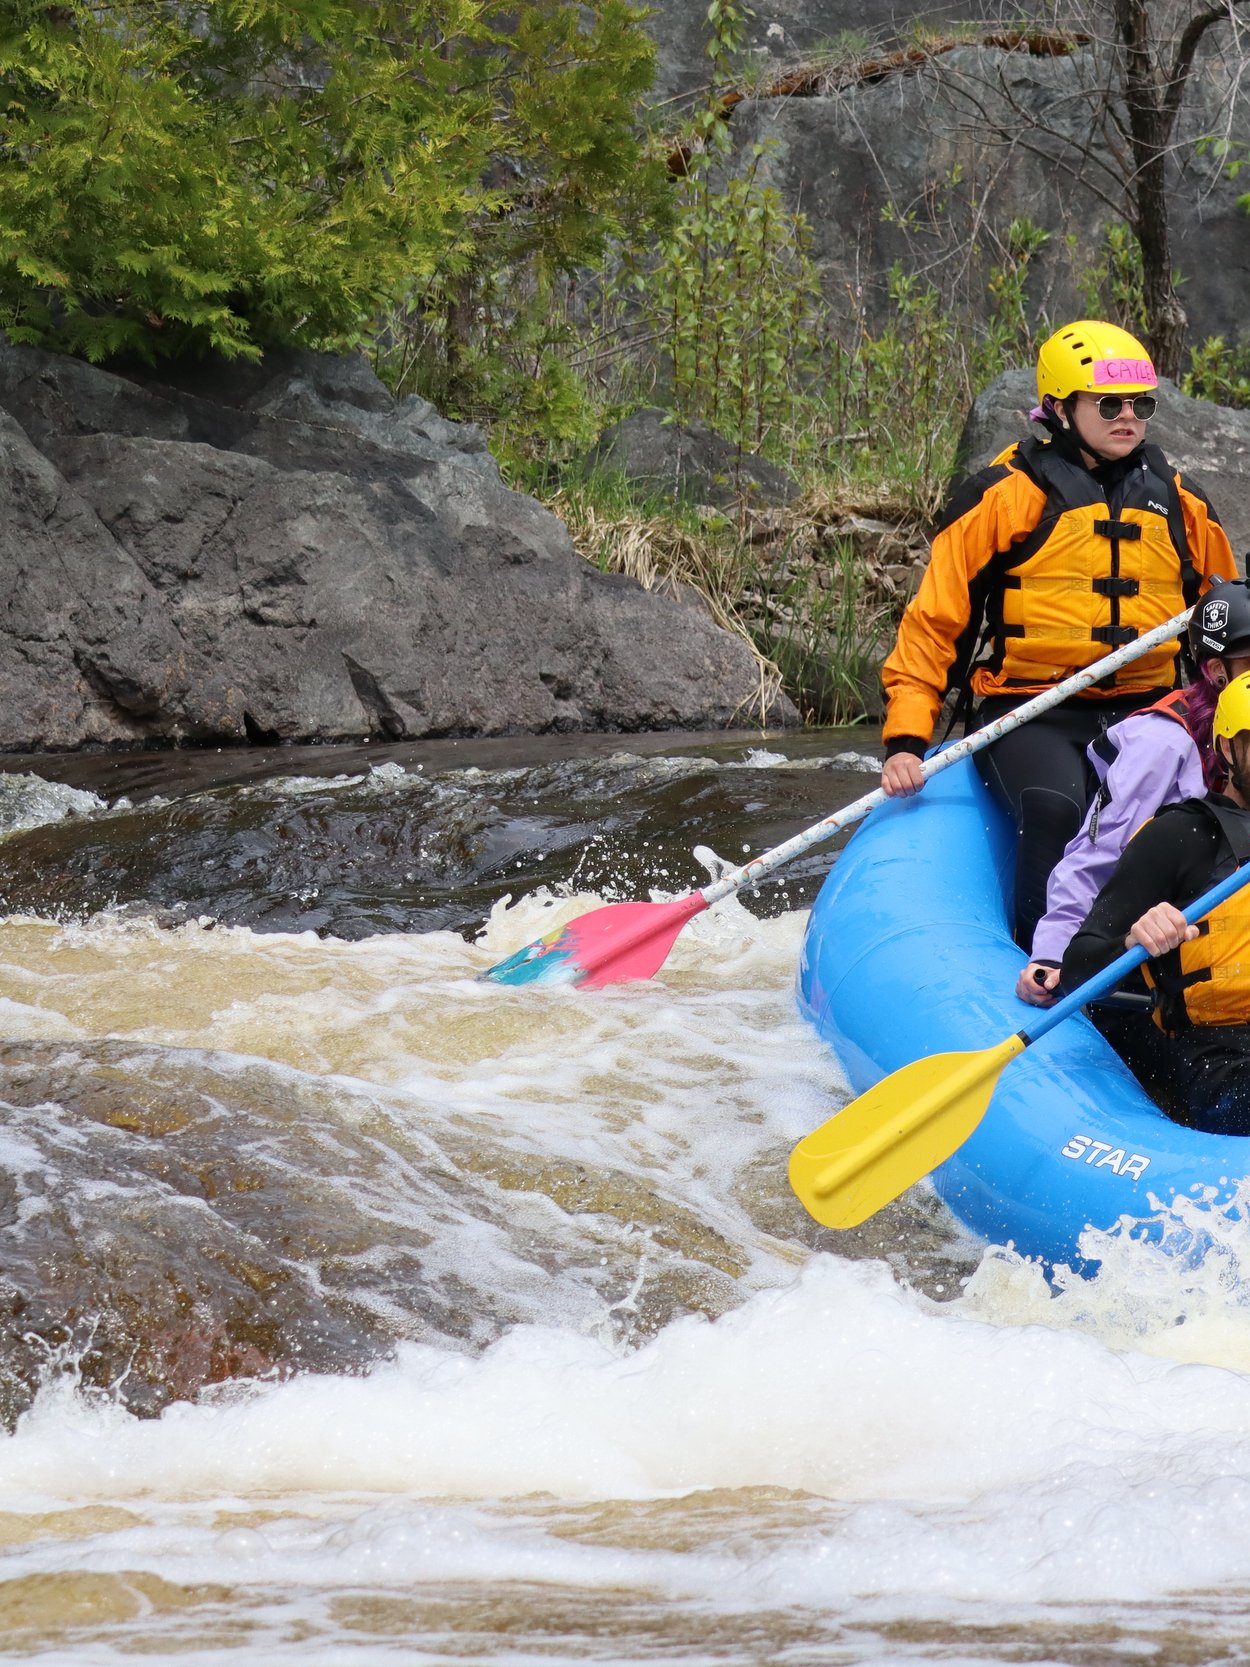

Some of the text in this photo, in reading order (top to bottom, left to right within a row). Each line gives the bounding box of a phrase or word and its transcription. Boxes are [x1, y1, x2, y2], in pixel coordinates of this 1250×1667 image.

[1147, 499, 1169, 515] NRS
[1206, 602, 1226, 613] SAFETY
[1207, 619, 1223, 629] THIRD
[1061, 1134, 1152, 1182] STAR
